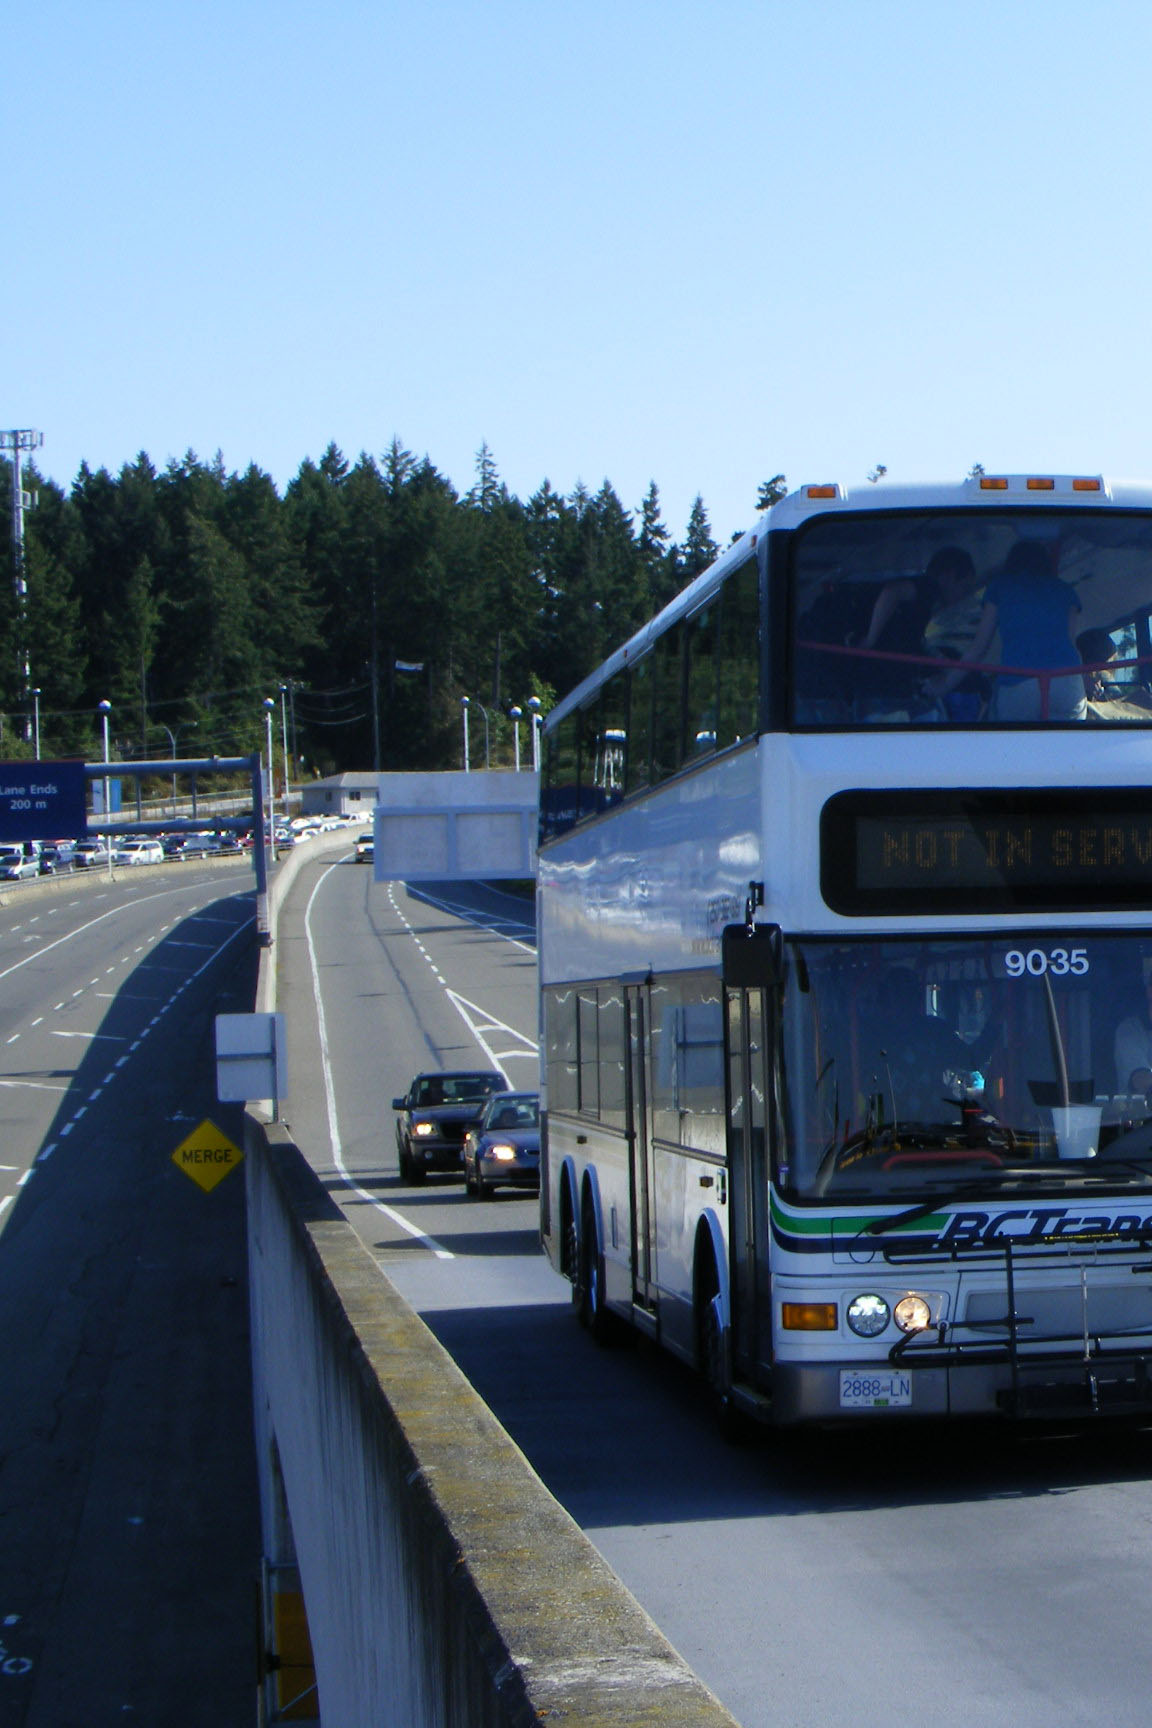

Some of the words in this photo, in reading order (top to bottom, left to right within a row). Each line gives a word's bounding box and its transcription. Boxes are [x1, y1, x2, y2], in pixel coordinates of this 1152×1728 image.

[0, 786, 26, 796] Lane
[30, 783, 58, 795] Ends
[10, 799, 31, 810] 200
[35, 801, 47, 809] m
[884, 830, 966, 868] NOT
[985, 829, 1032, 867] IN
[1005, 948, 1090, 977] 9035
[182, 1149, 233, 1164] MERGE
[843, 1380, 880, 1397] 2888
[890, 1379, 910, 1396] LN
